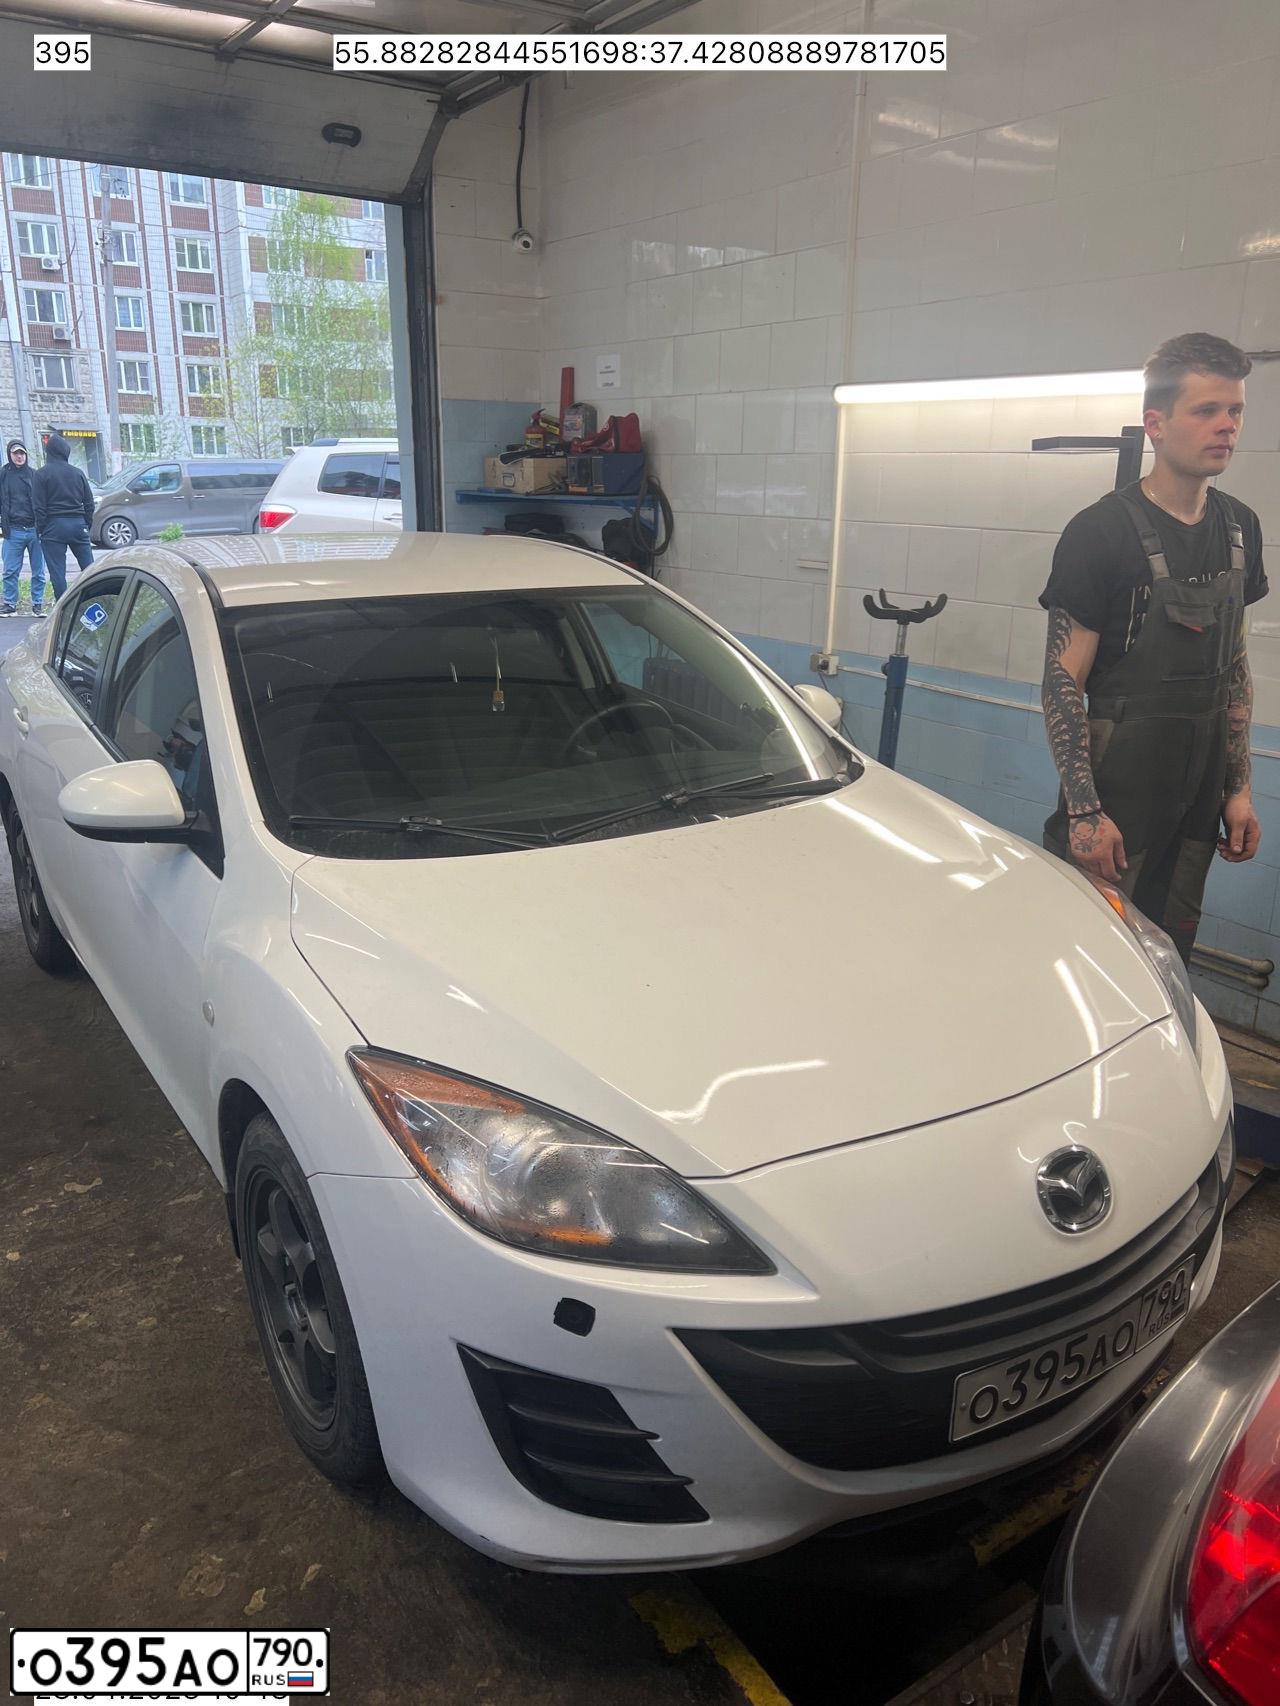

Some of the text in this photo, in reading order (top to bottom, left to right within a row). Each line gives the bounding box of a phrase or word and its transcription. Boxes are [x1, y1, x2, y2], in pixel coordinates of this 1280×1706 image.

[969, 1269, 1186, 1424] О395АО 790
[1149, 1312, 1171, 1336] RUS
